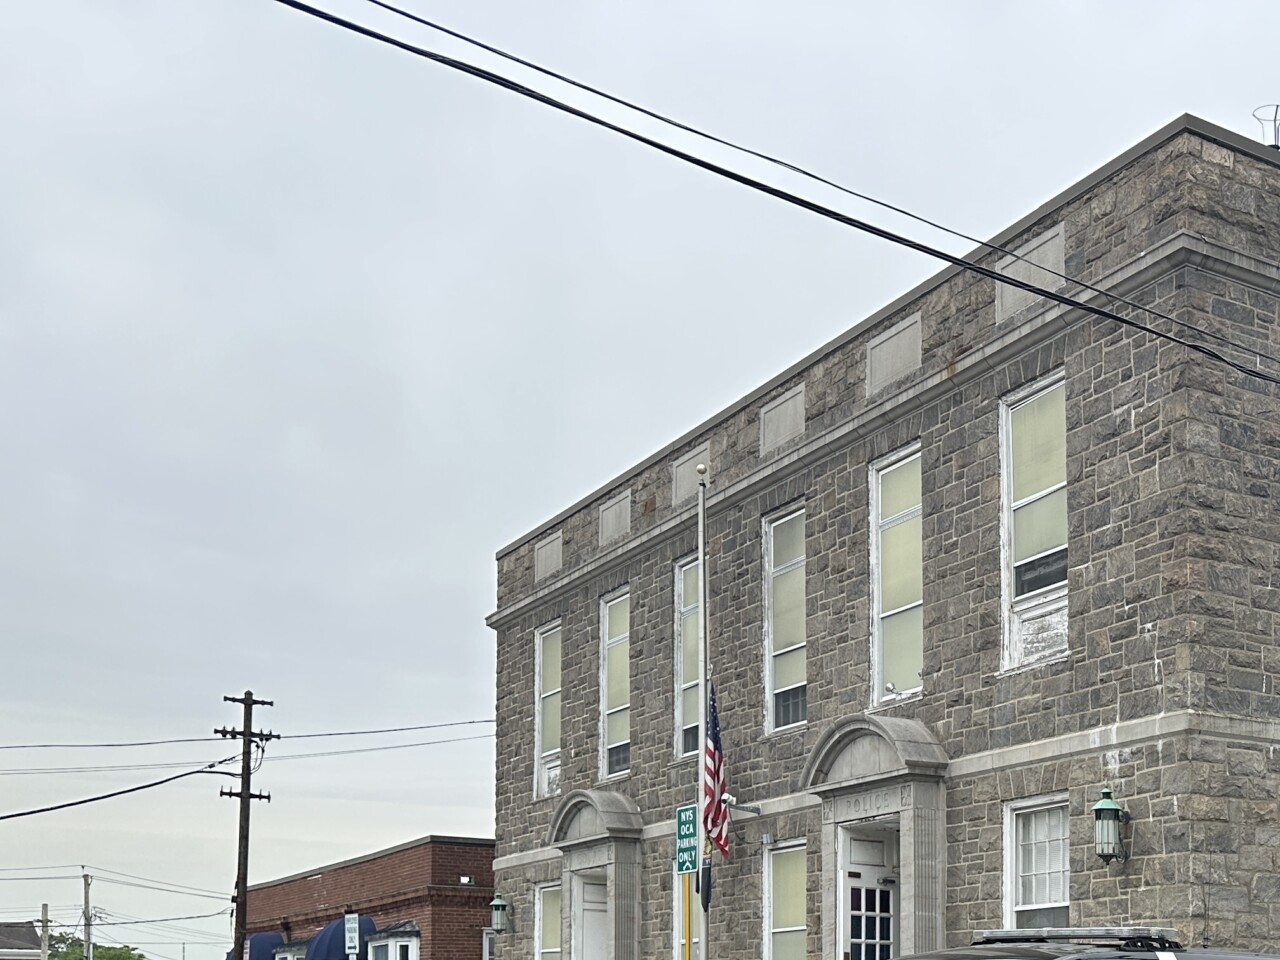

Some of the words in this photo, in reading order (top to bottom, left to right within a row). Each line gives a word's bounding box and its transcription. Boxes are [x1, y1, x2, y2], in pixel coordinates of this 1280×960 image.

[846, 793, 889, 816] POLICE
[681, 810, 693, 822] NYS
[681, 824, 694, 835] OCA
[678, 837, 697, 849] PARKING
[679, 850, 696, 862] ONLY
